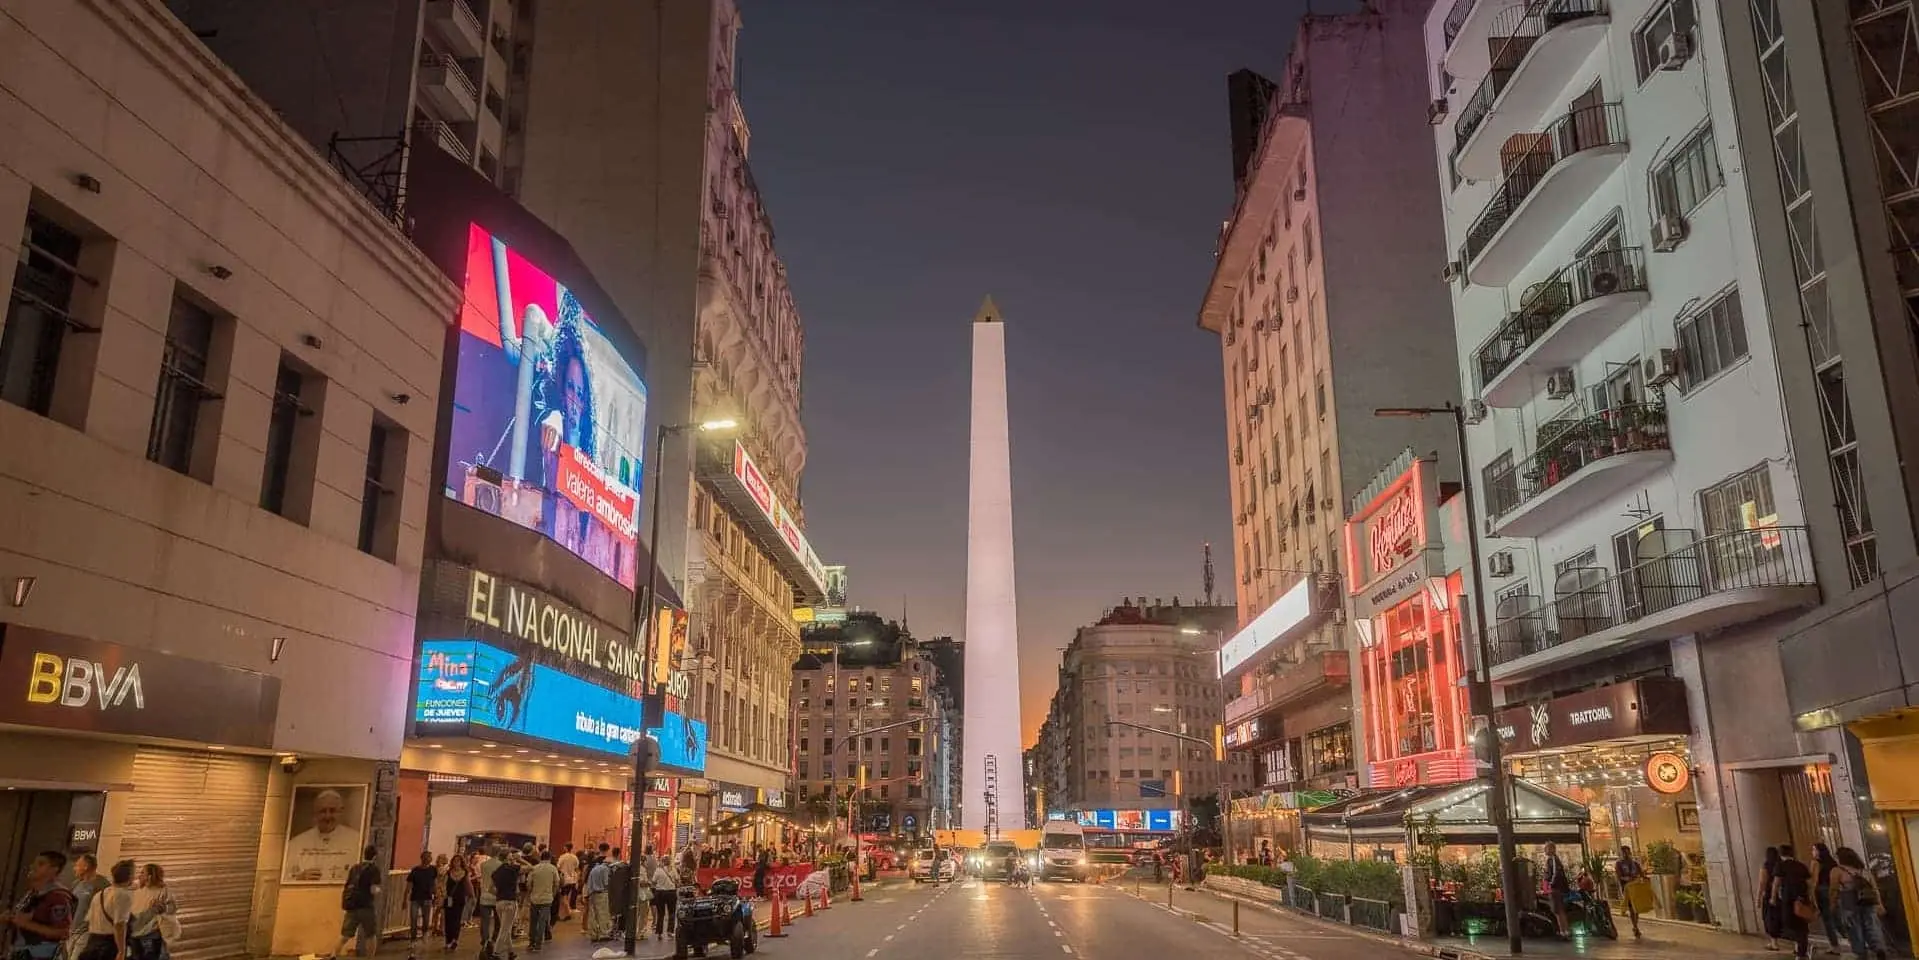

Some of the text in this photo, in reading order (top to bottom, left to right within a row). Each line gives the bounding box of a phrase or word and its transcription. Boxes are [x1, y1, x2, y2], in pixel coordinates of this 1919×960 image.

[565, 467, 635, 541] valeria ambrosio
[471, 570, 500, 628] EL
[507, 586, 601, 669] NACIONAL
[653, 661, 689, 699] SGURO
[28, 652, 144, 710] BBVA
[1569, 706, 1613, 726] TRATTORIA
[74, 829, 97, 841] BBVA
